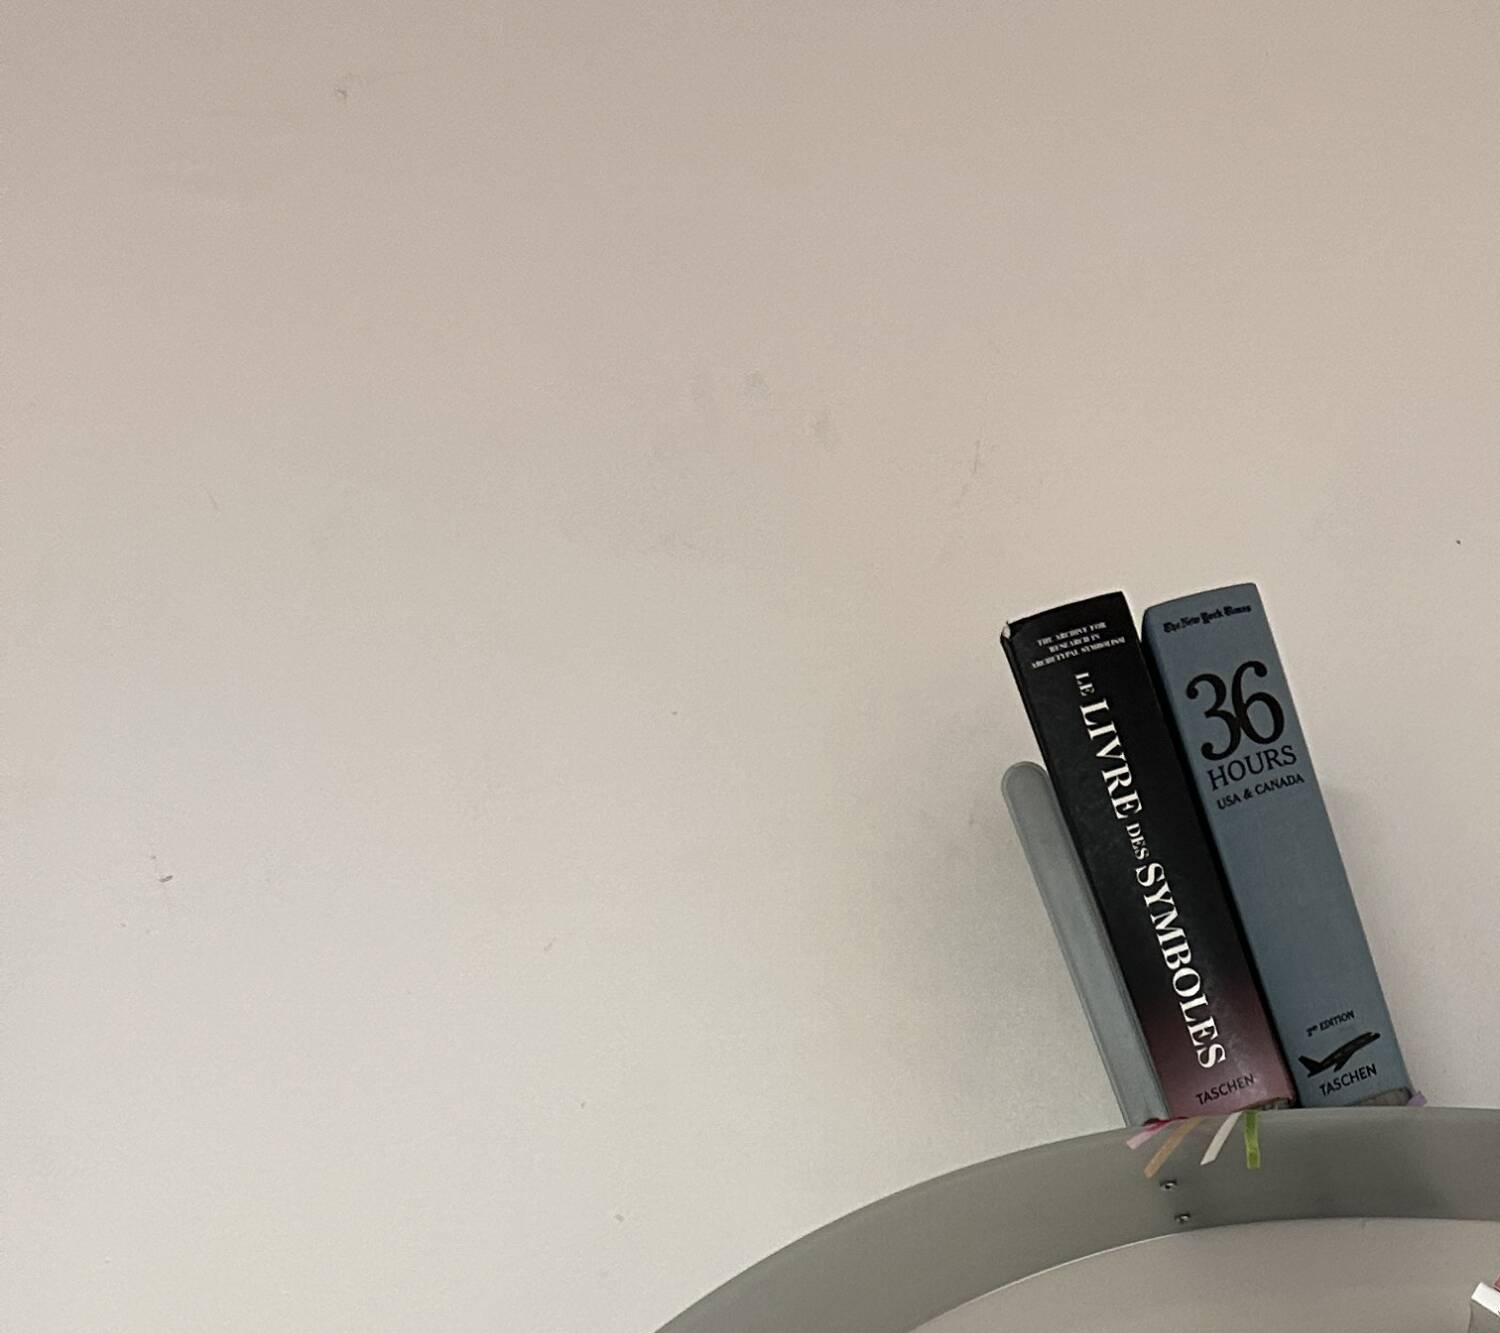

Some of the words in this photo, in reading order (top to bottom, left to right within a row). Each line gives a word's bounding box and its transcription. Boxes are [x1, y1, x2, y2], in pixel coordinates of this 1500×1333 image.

[1162, 619, 1181, 633] The
[1179, 613, 1201, 628] New
[1199, 607, 1224, 624] York
[1073, 670, 1095, 698] LE
[1178, 653, 1291, 764] 36
[1076, 696, 1145, 822] LIVRE
[1204, 741, 1299, 791] HOURS
[1215, 791, 1242, 810] USA
[1241, 786, 1254, 800] &
[1252, 769, 1306, 797] CANADA
[1123, 821, 1152, 862] DES
[1130, 859, 1231, 1071] SYMBOLES
[1317, 1009, 1356, 1031] EDITION
[1195, 1072, 1254, 1106] TASCHEN
[1318, 1063, 1378, 1098] TASCHEN
